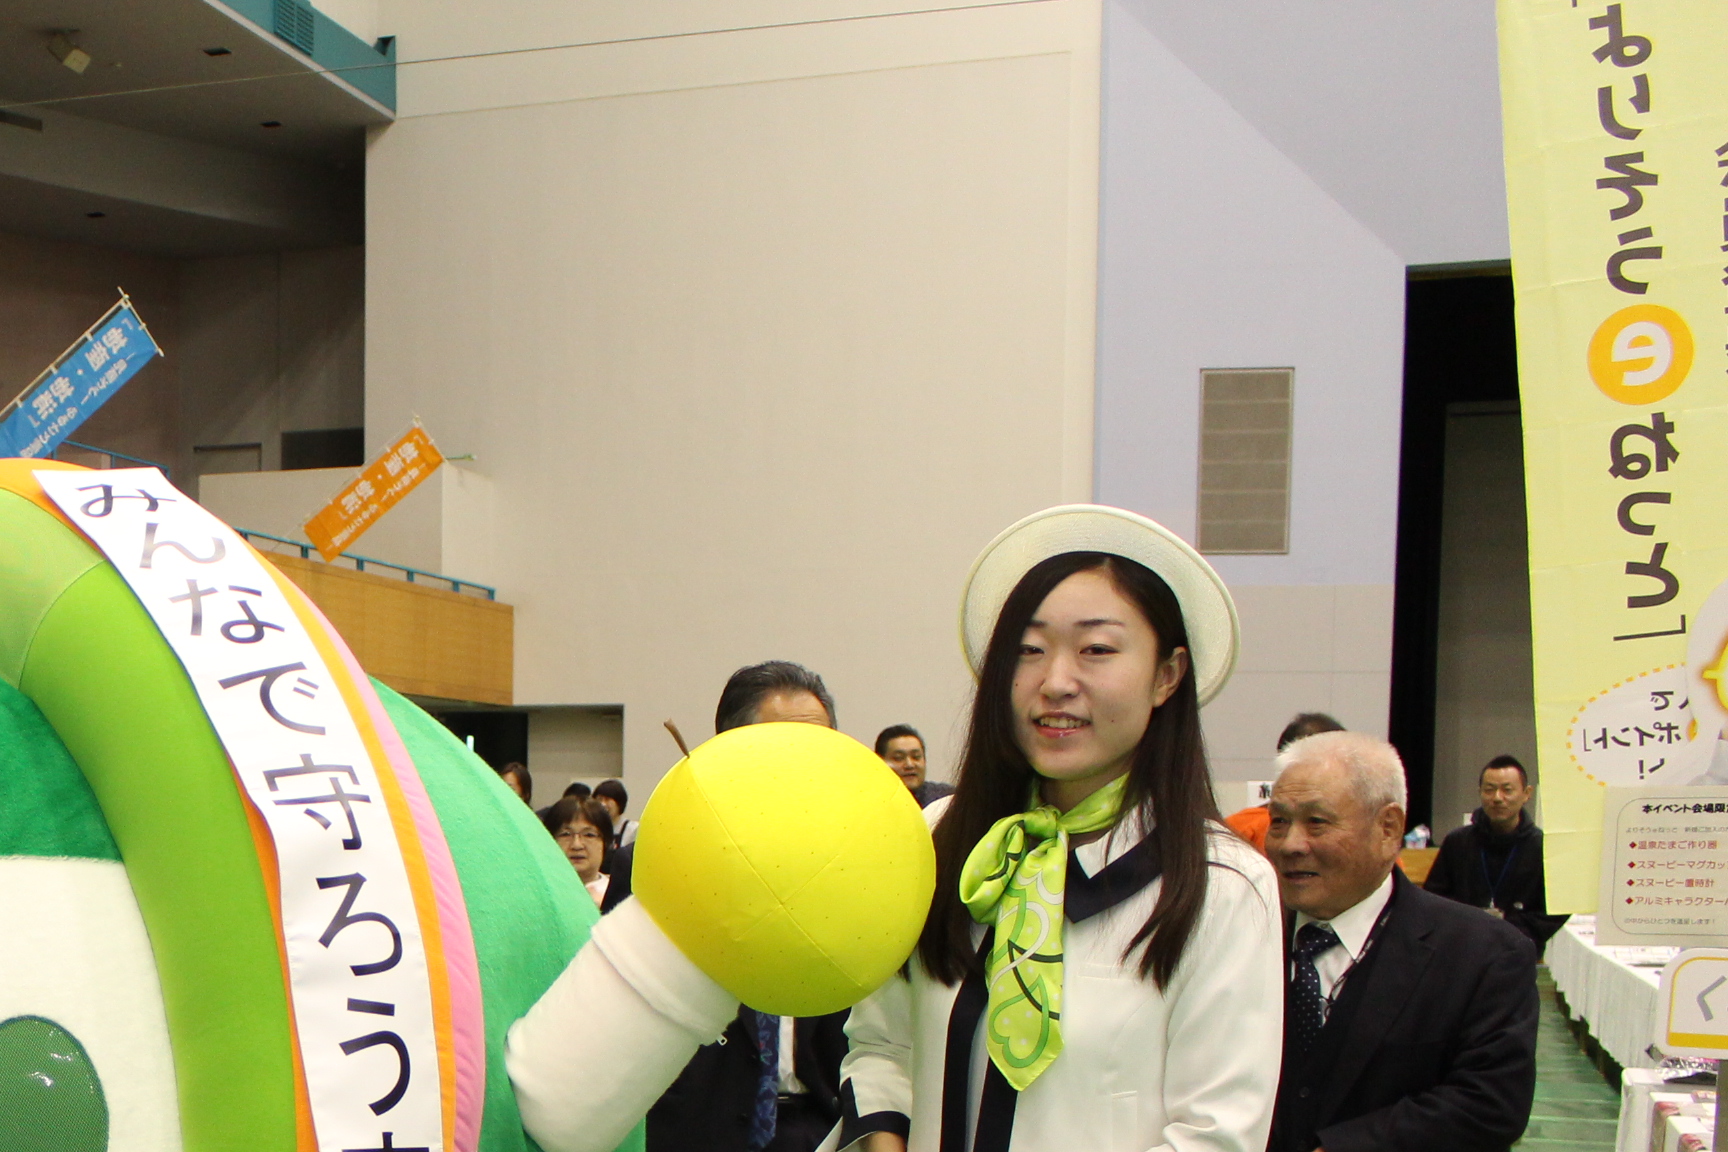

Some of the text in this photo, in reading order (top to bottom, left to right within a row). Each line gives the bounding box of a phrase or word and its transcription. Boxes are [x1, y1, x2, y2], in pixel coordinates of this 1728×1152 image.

[1642, 803, 1728, 814] 本イベント会場限
[1634, 896, 1728, 906] アルミキャラクター
